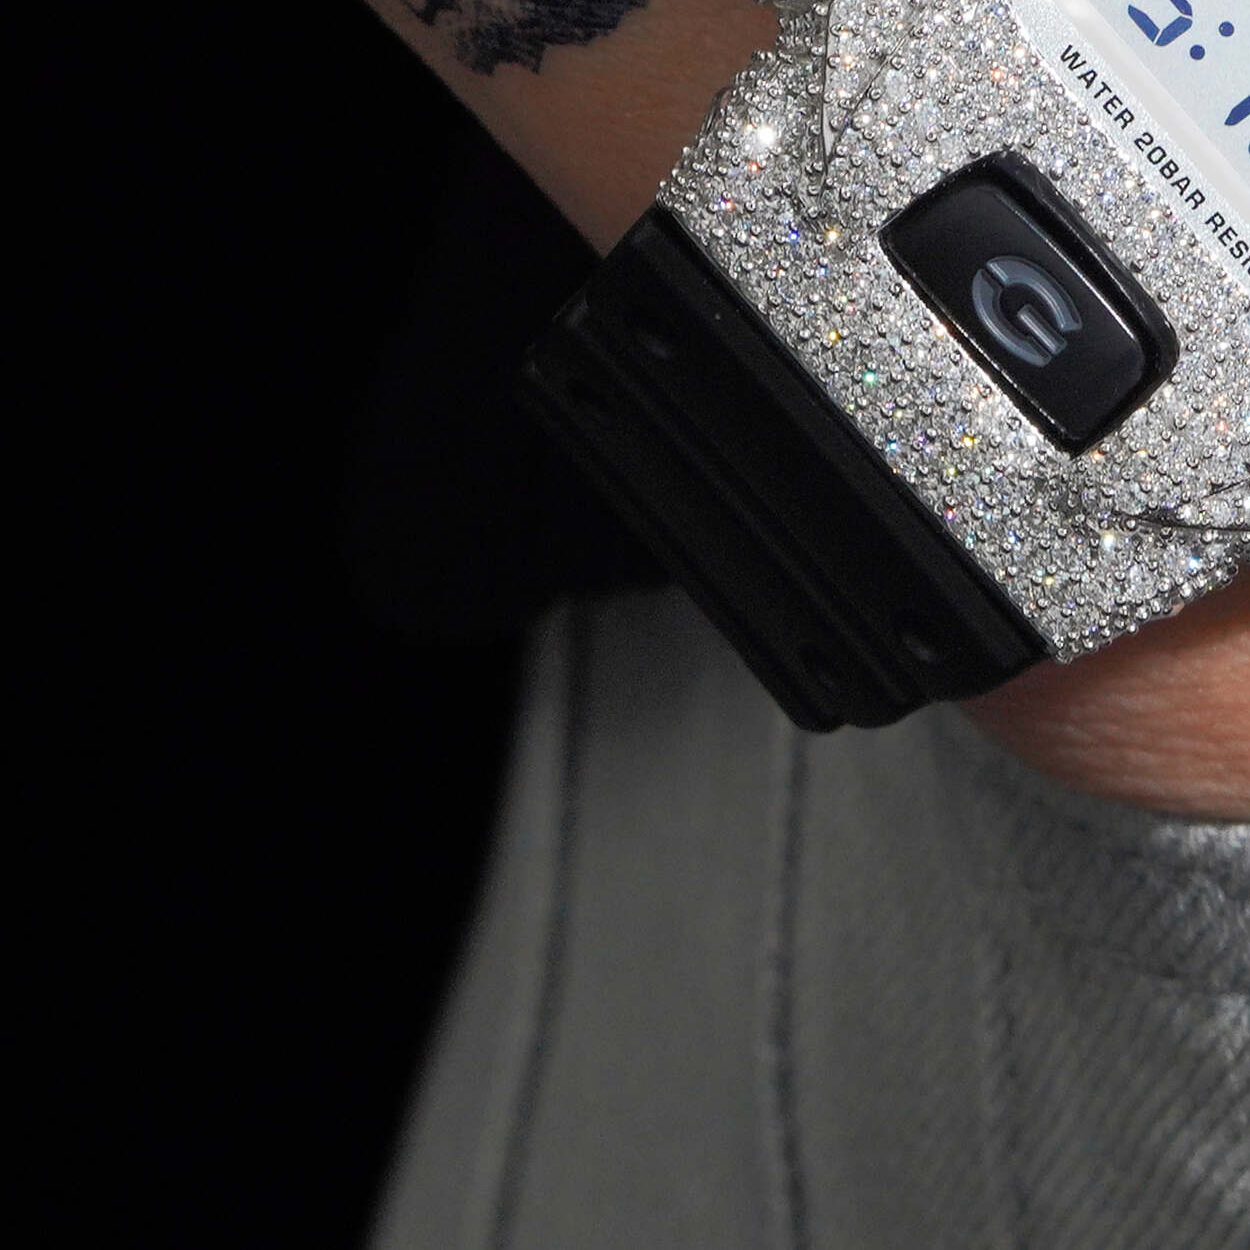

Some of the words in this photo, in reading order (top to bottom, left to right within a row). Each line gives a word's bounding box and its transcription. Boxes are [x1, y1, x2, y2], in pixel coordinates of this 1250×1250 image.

[1059, 43, 1135, 130] WATER
[1133, 131, 1206, 211] 20BAR
[971, 254, 1083, 368] G
